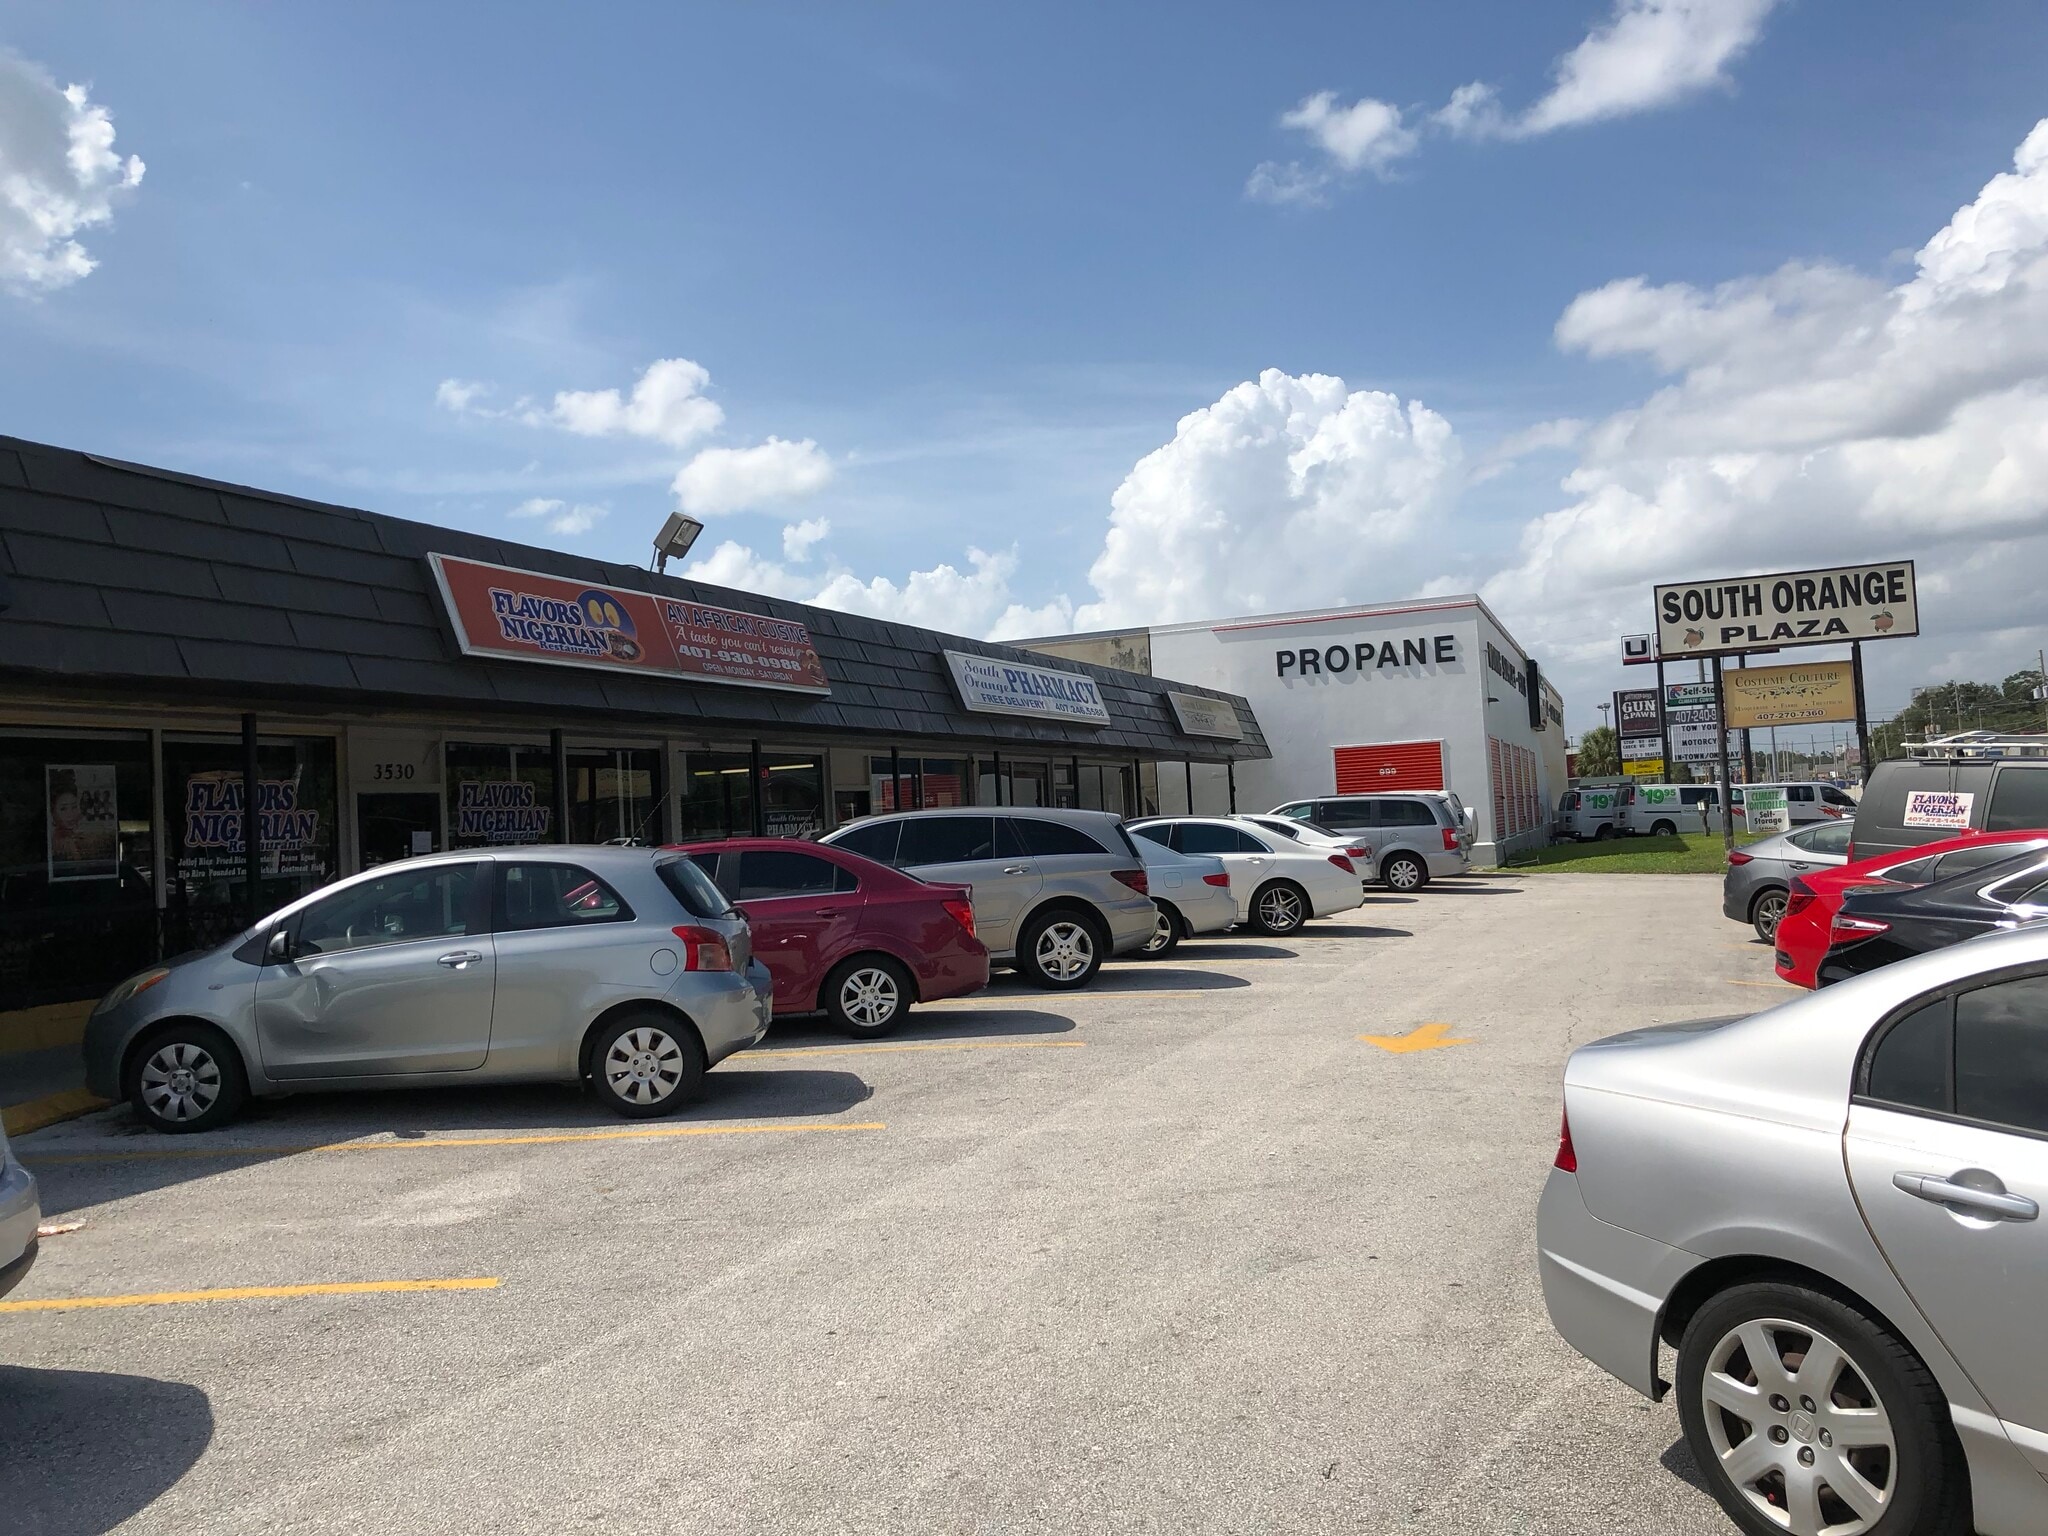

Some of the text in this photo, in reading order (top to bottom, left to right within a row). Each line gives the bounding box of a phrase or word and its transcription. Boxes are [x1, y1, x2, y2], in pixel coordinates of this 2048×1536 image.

[1662, 569, 1907, 624] SOUTH ORANGE
[491, 589, 583, 626] FLAVORS
[500, 616, 610, 651] NIGERIAN
[667, 603, 811, 645] AN AFRICAN CUISINE
[1720, 617, 1850, 644] PLAZA
[539, 640, 602, 657] Restaurant
[674, 625, 687, 641] A
[690, 630, 718, 645] taste
[721, 637, 741, 651] you
[744, 640, 767, 653] can't
[679, 644, 801, 671] 407-930-0988
[1276, 635, 1456, 677] PROPANE
[725, 664, 756, 677] MONDAY
[964, 659, 1000, 679] South
[964, 674, 1010, 694] Orange
[1003, 668, 1098, 705] PHARMACY
[1683, 686, 1715, 696] Self-Sto
[981, 693, 1003, 705] FREE
[1005, 696, 1046, 710] DELIVERY
[1622, 700, 1656, 713] GUN
[1630, 711, 1656, 719] PAWN
[373, 763, 415, 780] 3530
[461, 784, 533, 807] FLAVORS
[1751, 790, 1780, 801] CLIMATE
[1913, 794, 1959, 805] FLAVORS
[1911, 804, 1968, 815] NIGERIAN
[461, 809, 548, 833] NIGERIAN
[1754, 817, 1782, 825] Storage
[487, 831, 538, 841] Restaurant
